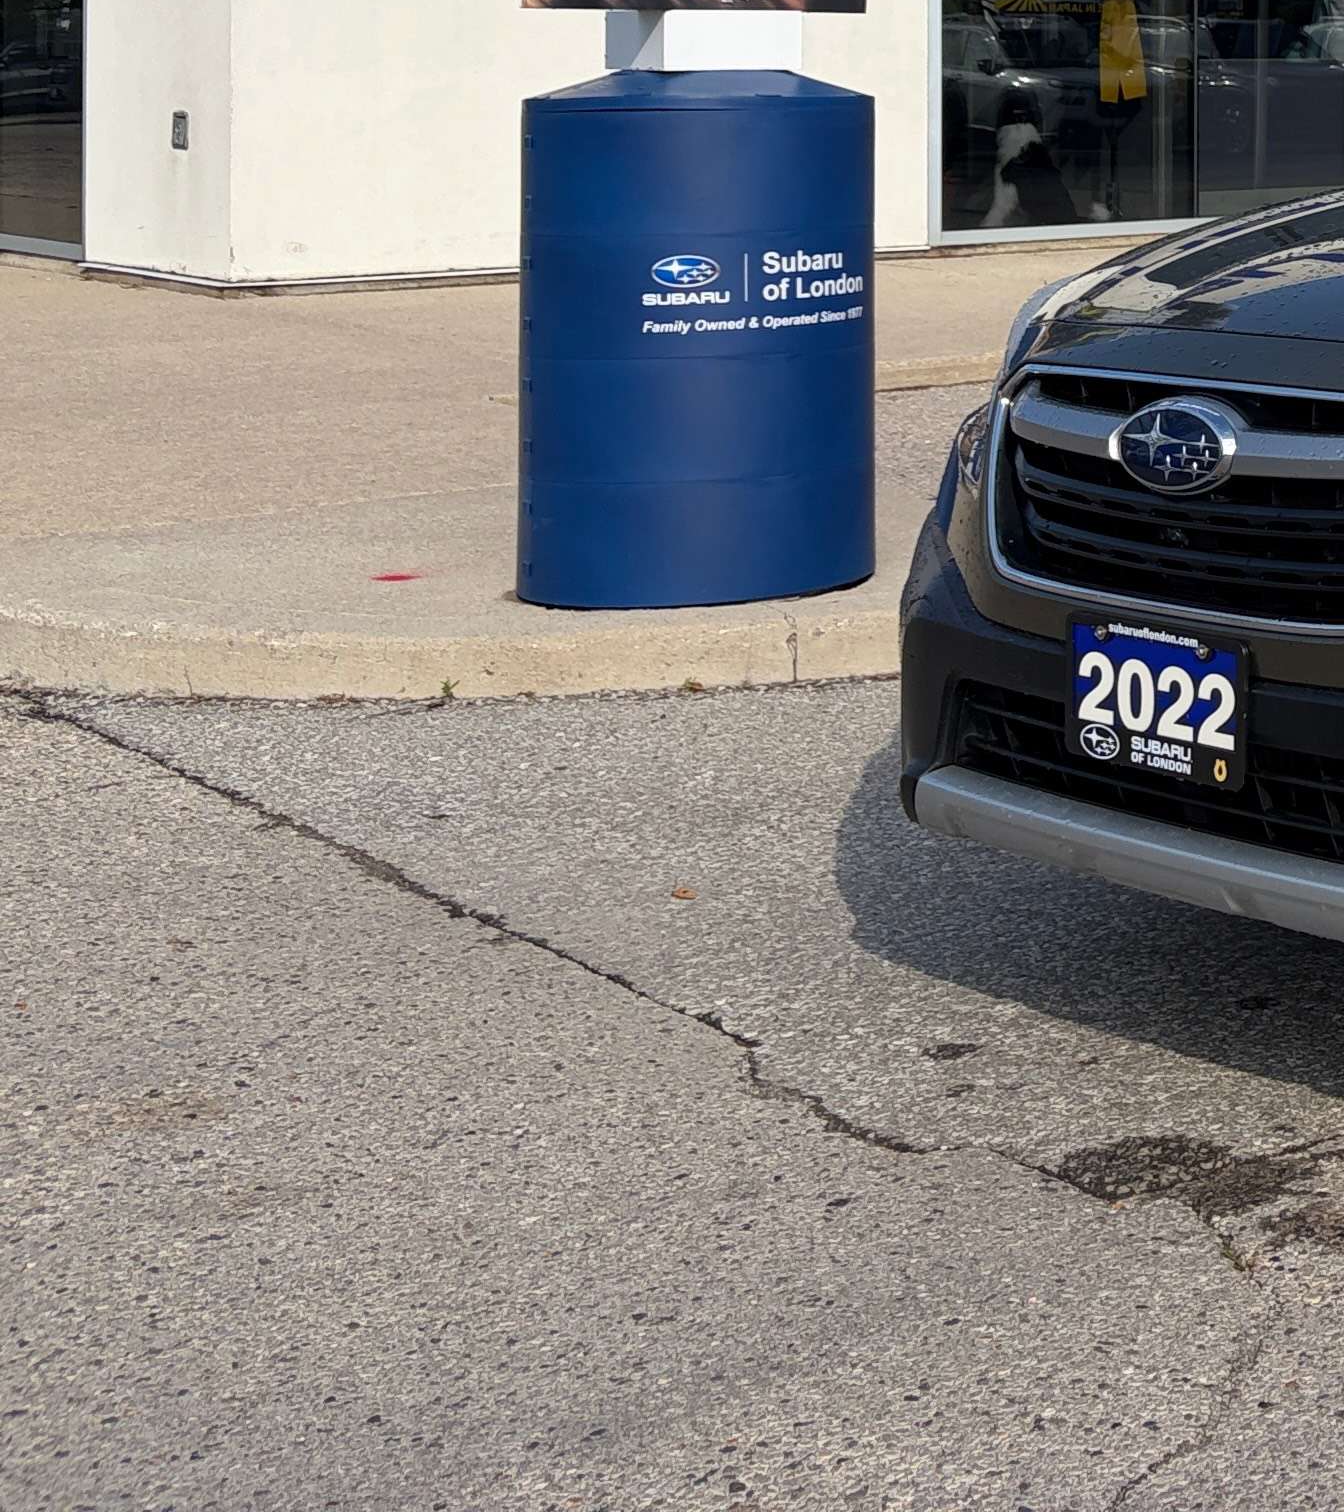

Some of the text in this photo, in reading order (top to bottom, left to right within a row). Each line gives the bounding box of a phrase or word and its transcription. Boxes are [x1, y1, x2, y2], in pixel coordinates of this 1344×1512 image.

[762, 249, 843, 274] Subaru
[641, 291, 730, 307] SUBARU
[762, 273, 863, 302] of London
[642, 320, 691, 335] Family
[694, 317, 745, 332] Owned
[748, 316, 760, 329] &
[762, 311, 819, 330] Operated
[819, 310, 846, 323] Since
[1108, 622, 1199, 648] subaruoflondon.com
[1078, 651, 1236, 752] 2022
[1130, 735, 1192, 762] SUBARU
[1130, 751, 1192, 775] OF LONDON
